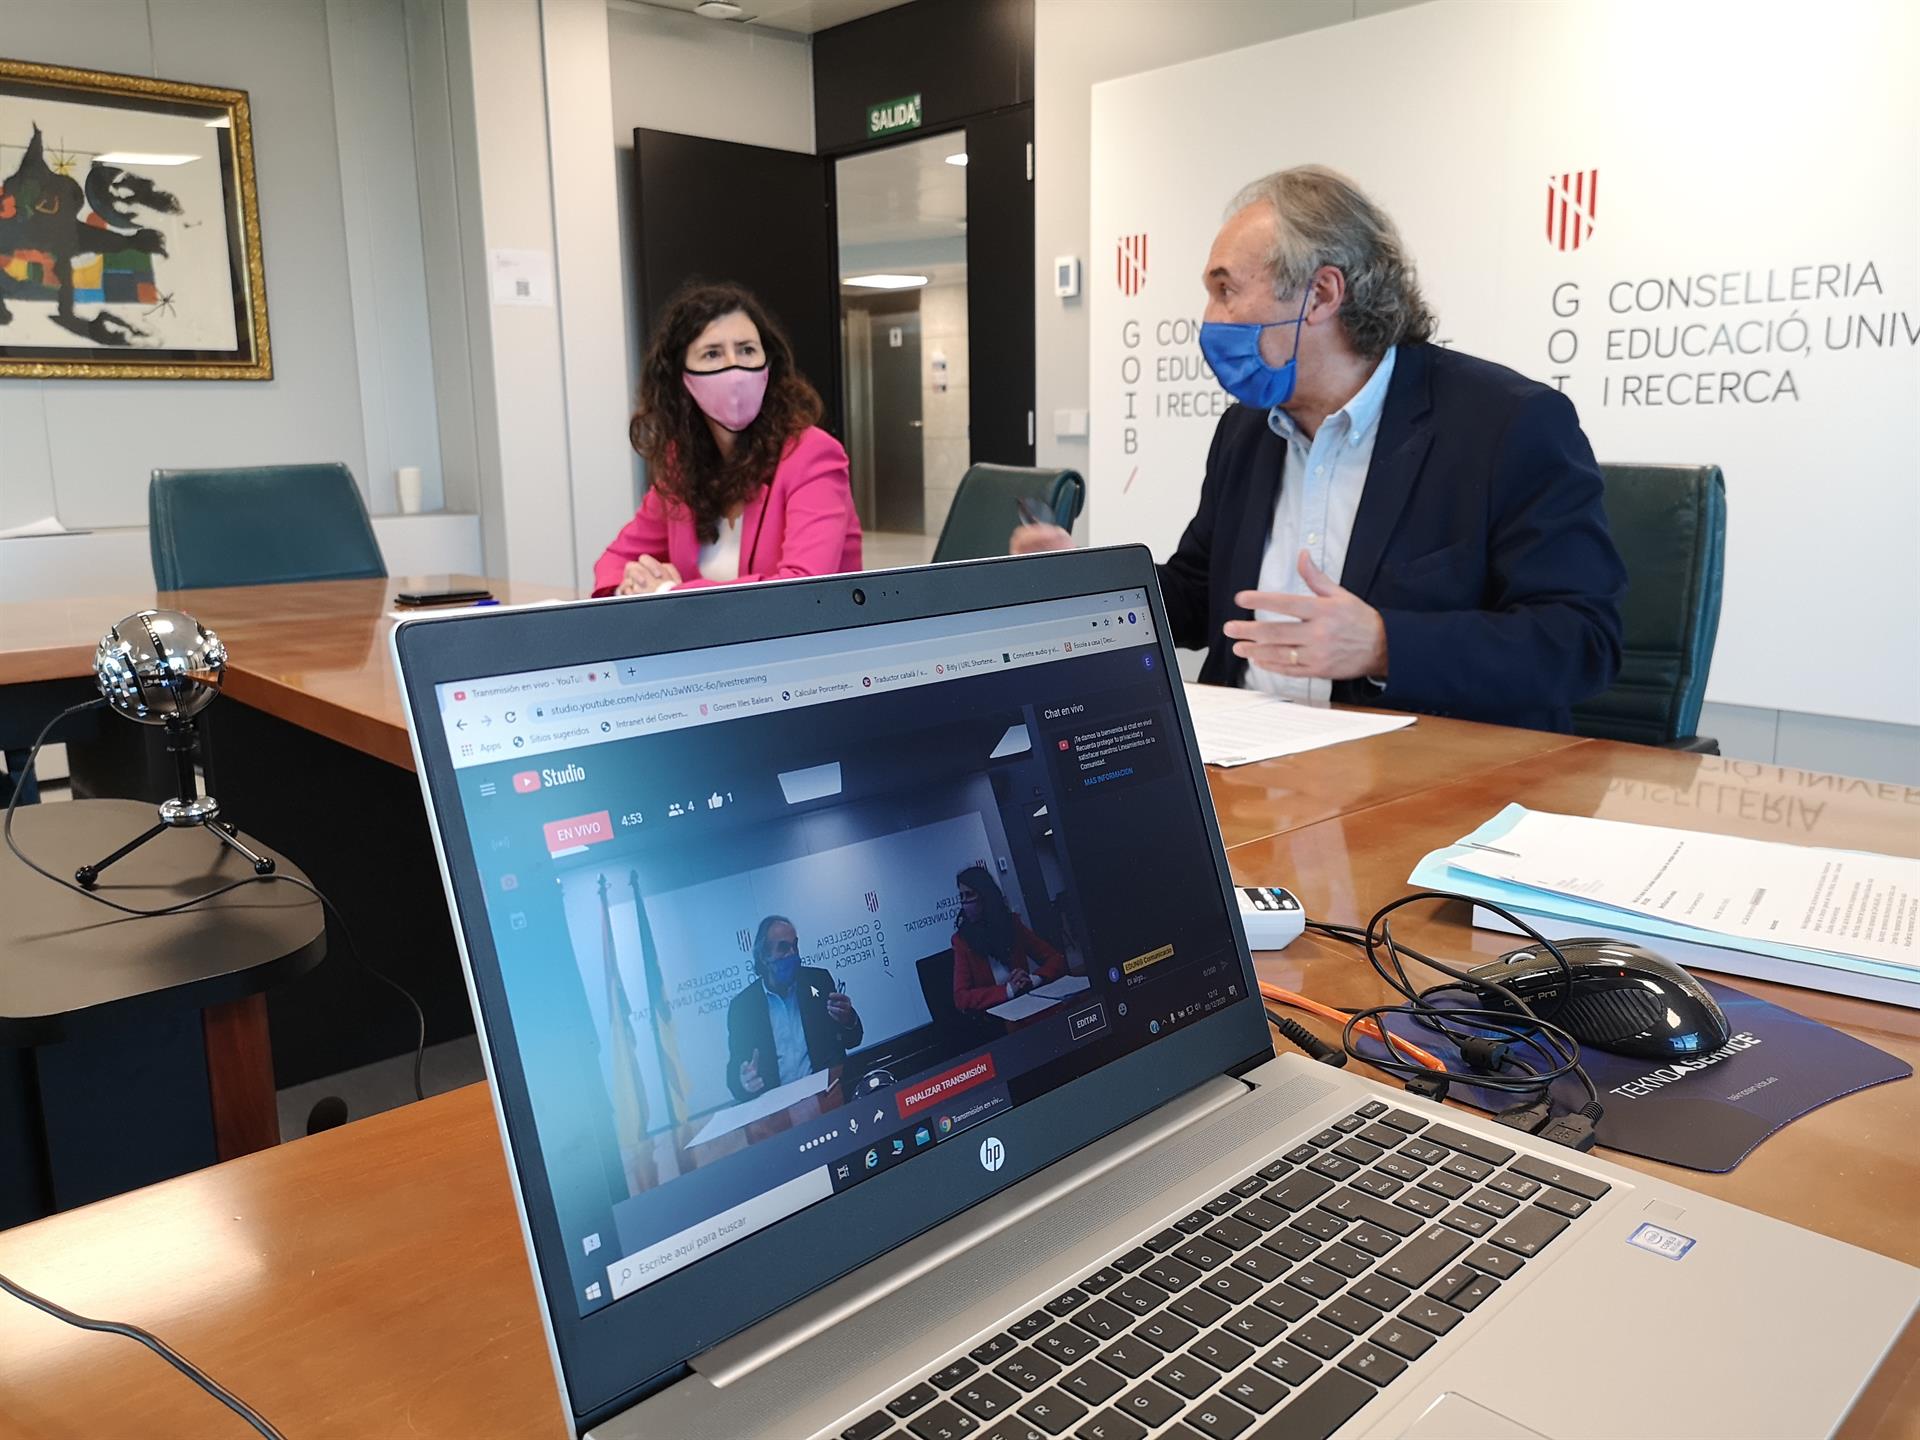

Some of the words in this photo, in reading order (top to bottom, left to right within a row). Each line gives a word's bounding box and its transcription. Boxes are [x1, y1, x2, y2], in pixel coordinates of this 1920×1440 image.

[871, 102, 917, 132] SALIDA
[1608, 261, 1883, 314] CONSELLERIA
[1606, 309, 1811, 360] EDUCACIÓ,
[1825, 311, 1920, 350] UNIV
[1603, 376, 1609, 407] I
[1622, 369, 1799, 407] RECERCA
[471, 683, 521, 698] Transmisión
[522, 683, 532, 692] en
[533, 680, 550, 690] vivo
[480, 742, 502, 754] Apps
[529, 734, 552, 745] Sitios
[552, 727, 591, 742] sugeridos
[616, 716, 645, 729] Intranet
[645, 713, 657, 724] del
[712, 701, 737, 713] Govern
[751, 694, 774, 706] Balears
[794, 687, 818, 699] Calcular
[873, 674, 899, 685] Traductor
[1044, 707, 1061, 720] Chat
[1061, 706, 1070, 716] en
[1070, 703, 1085, 714] vivo
[1076, 742, 1097, 752] Recuerda
[1096, 737, 1115, 748] proteger
[1078, 751, 1100, 761] satisfacer
[1100, 746, 1118, 756] nuestros
[542, 764, 586, 788] Studio
[727, 793, 733, 803] 1
[687, 801, 695, 812] 4
[621, 812, 643, 827] 4:53
[556, 828, 574, 842] EN
[574, 822, 601, 837] VIVO
[1537, 989, 1558, 1003] Pro
[1076, 1014, 1098, 1030] EDITAR
[905, 1083, 942, 1107] FINALIZAR
[941, 1063, 988, 1091] TRANSMISIÓN
[951, 1103, 984, 1124] Transmisión
[983, 1101, 992, 1110] en
[1362, 1180, 1373, 1188] 7
[1500, 1181, 1512, 1189] 3
[1409, 1198, 1420, 1206] 4
[1478, 1199, 1491, 1207] 2
[639, 1251, 673, 1275] Escribe
[674, 1242, 696, 1259] aquí
[696, 1231, 718, 1249] para
[717, 1216, 747, 1237] buscar
[1246, 1260, 1257, 1268] P
[1168, 1276, 1180, 1284] 9
[1217, 1279, 1230, 1288] O
[1300, 1276, 1315, 1285] Ñ
[1135, 1299, 1148, 1307] 8
[1269, 1299, 1285, 1307] L
[1099, 1321, 1110, 1330] 7
[1148, 1325, 1163, 1335] U
[1238, 1320, 1254, 1330] K
[1063, 1346, 1076, 1355] 6
[1112, 1350, 1127, 1359] Y
[1207, 1345, 1218, 1356] J
[1271, 1356, 1289, 1369] M
[1023, 1372, 1037, 1382] 5
[1073, 1376, 1088, 1386] T
[1169, 1370, 1185, 1381] H
[1237, 1383, 1254, 1396] N
[985, 1400, 996, 1409] 4
[1134, 1397, 1149, 1408] G
[1034, 1405, 1050, 1416] R
[1201, 1412, 1218, 1424] B
[938, 1428, 952, 1439] 3
[1092, 1426, 1104, 1438] F
